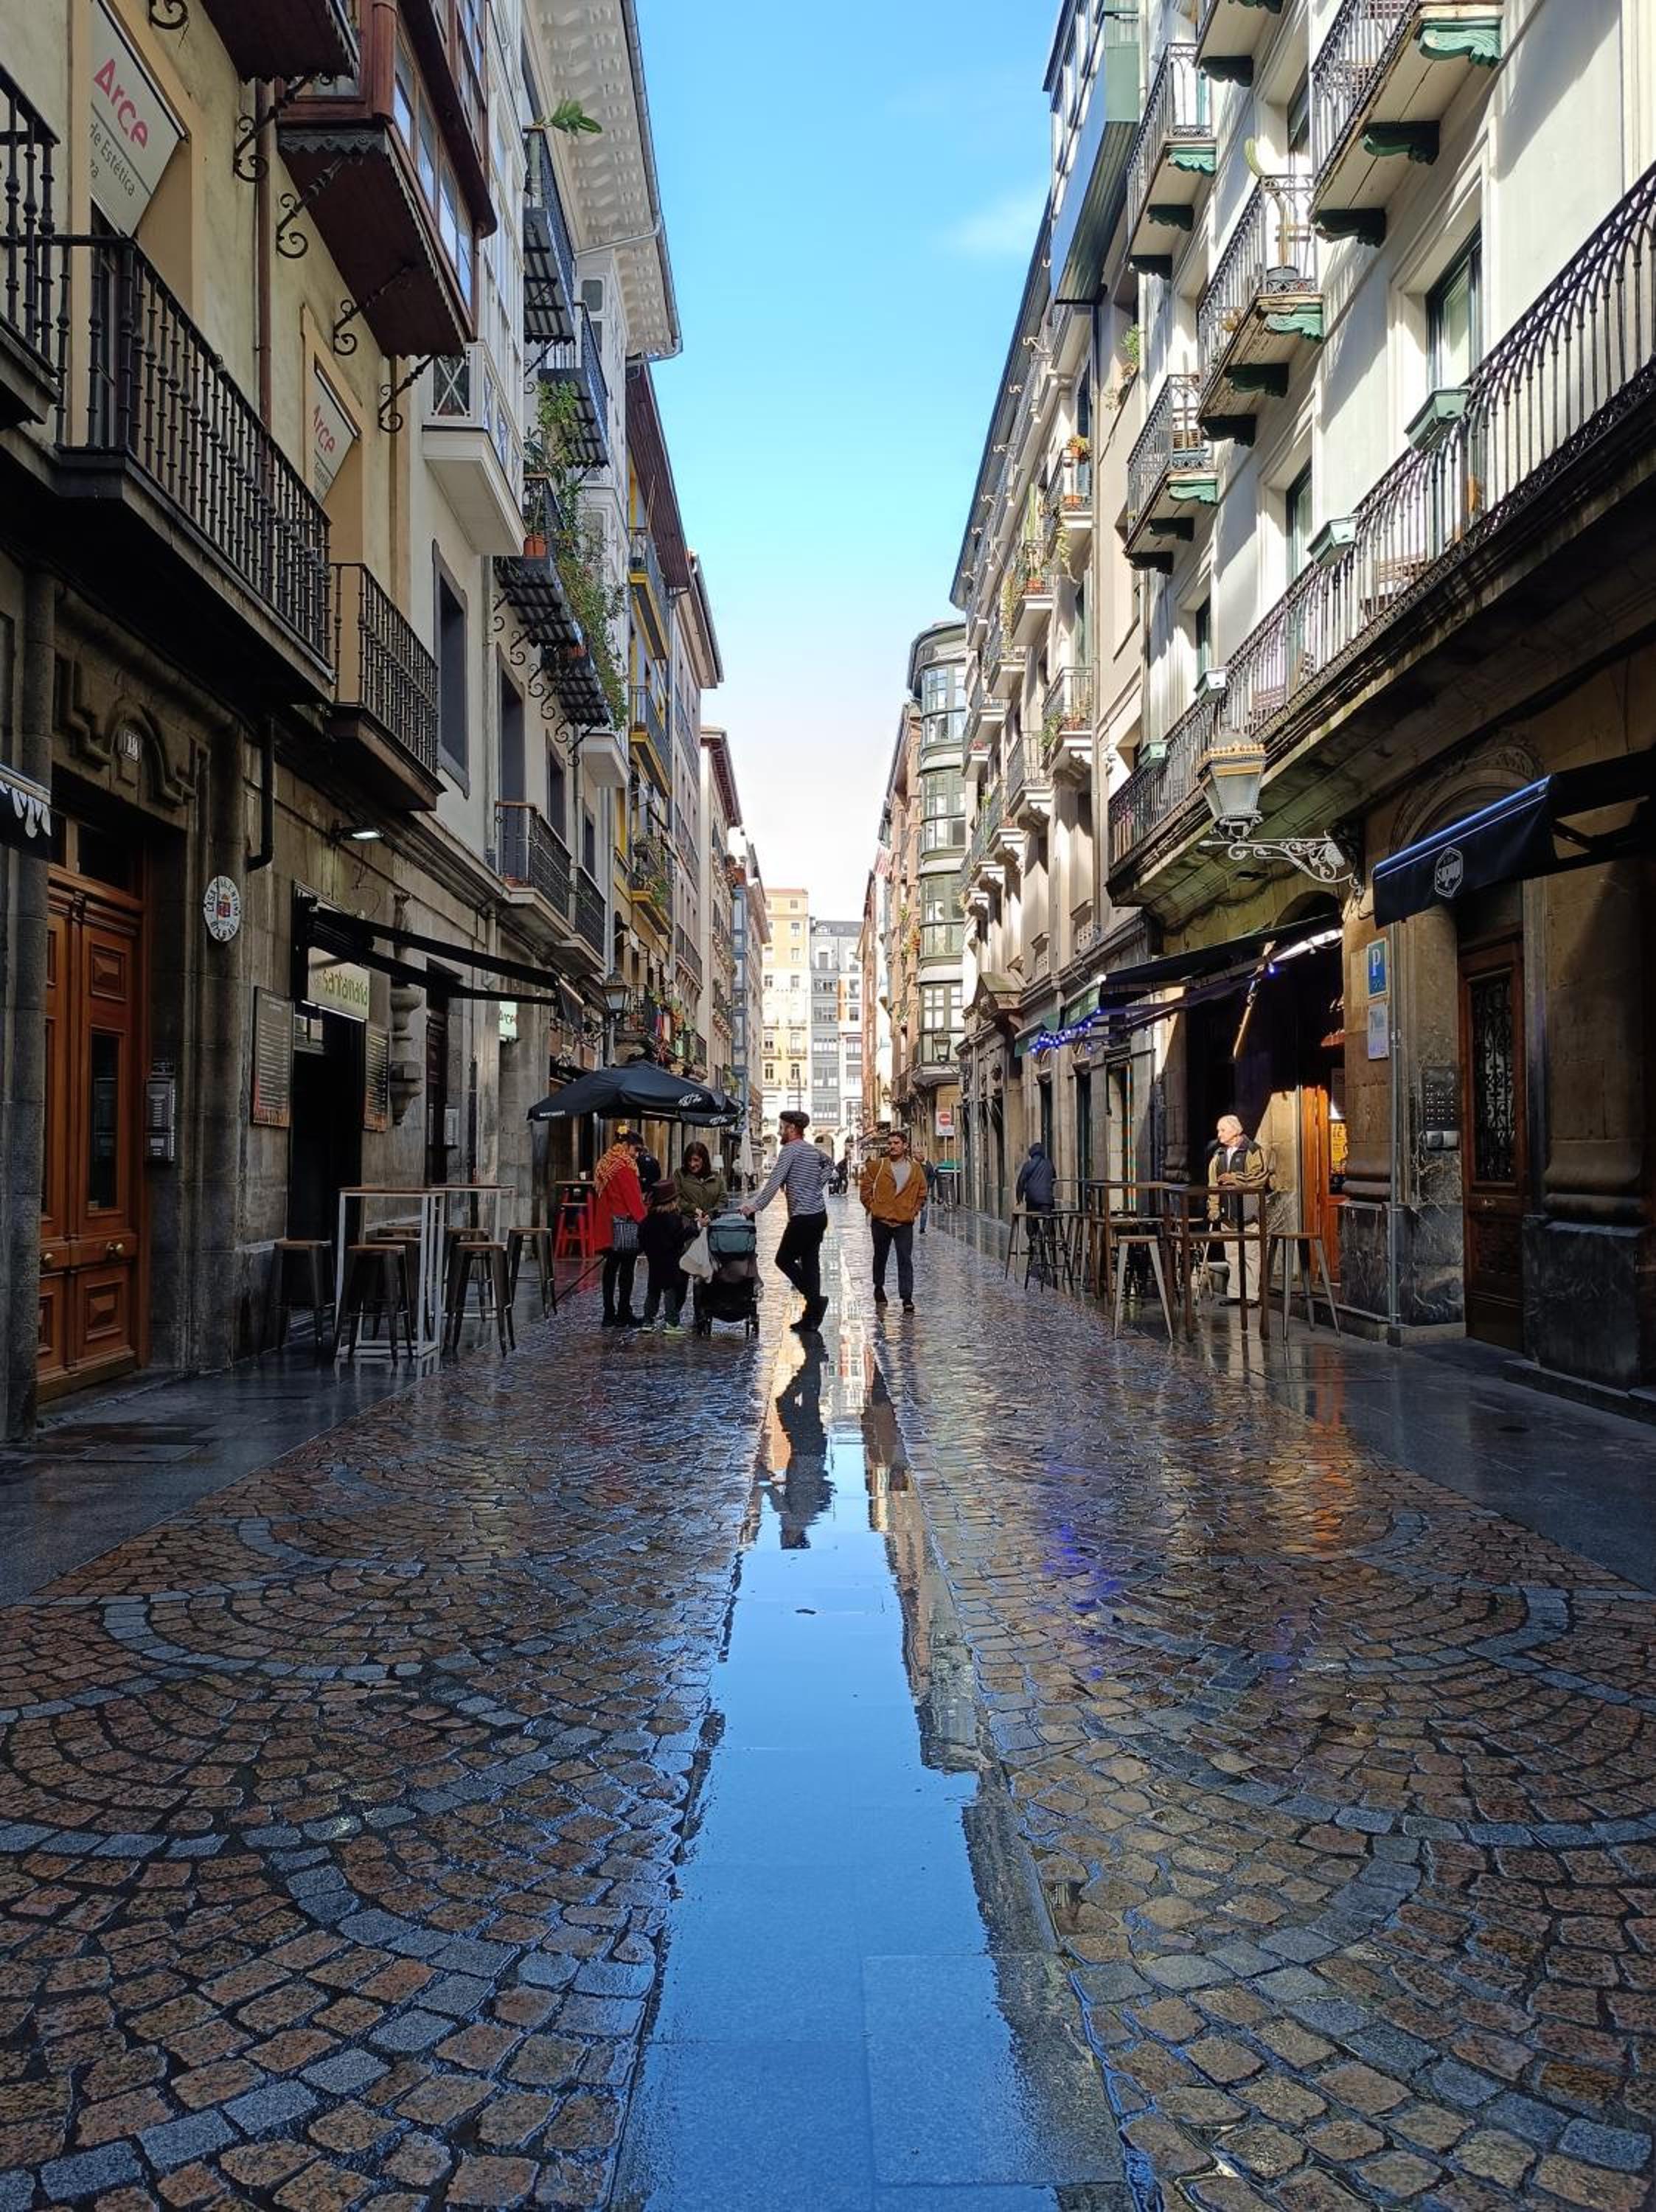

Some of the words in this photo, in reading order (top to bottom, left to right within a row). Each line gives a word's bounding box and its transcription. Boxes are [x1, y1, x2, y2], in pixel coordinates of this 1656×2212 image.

[94, 58, 148, 149] Arce
[100, 139, 136, 197] Estética
[1371, 948, 1381, 977] P
